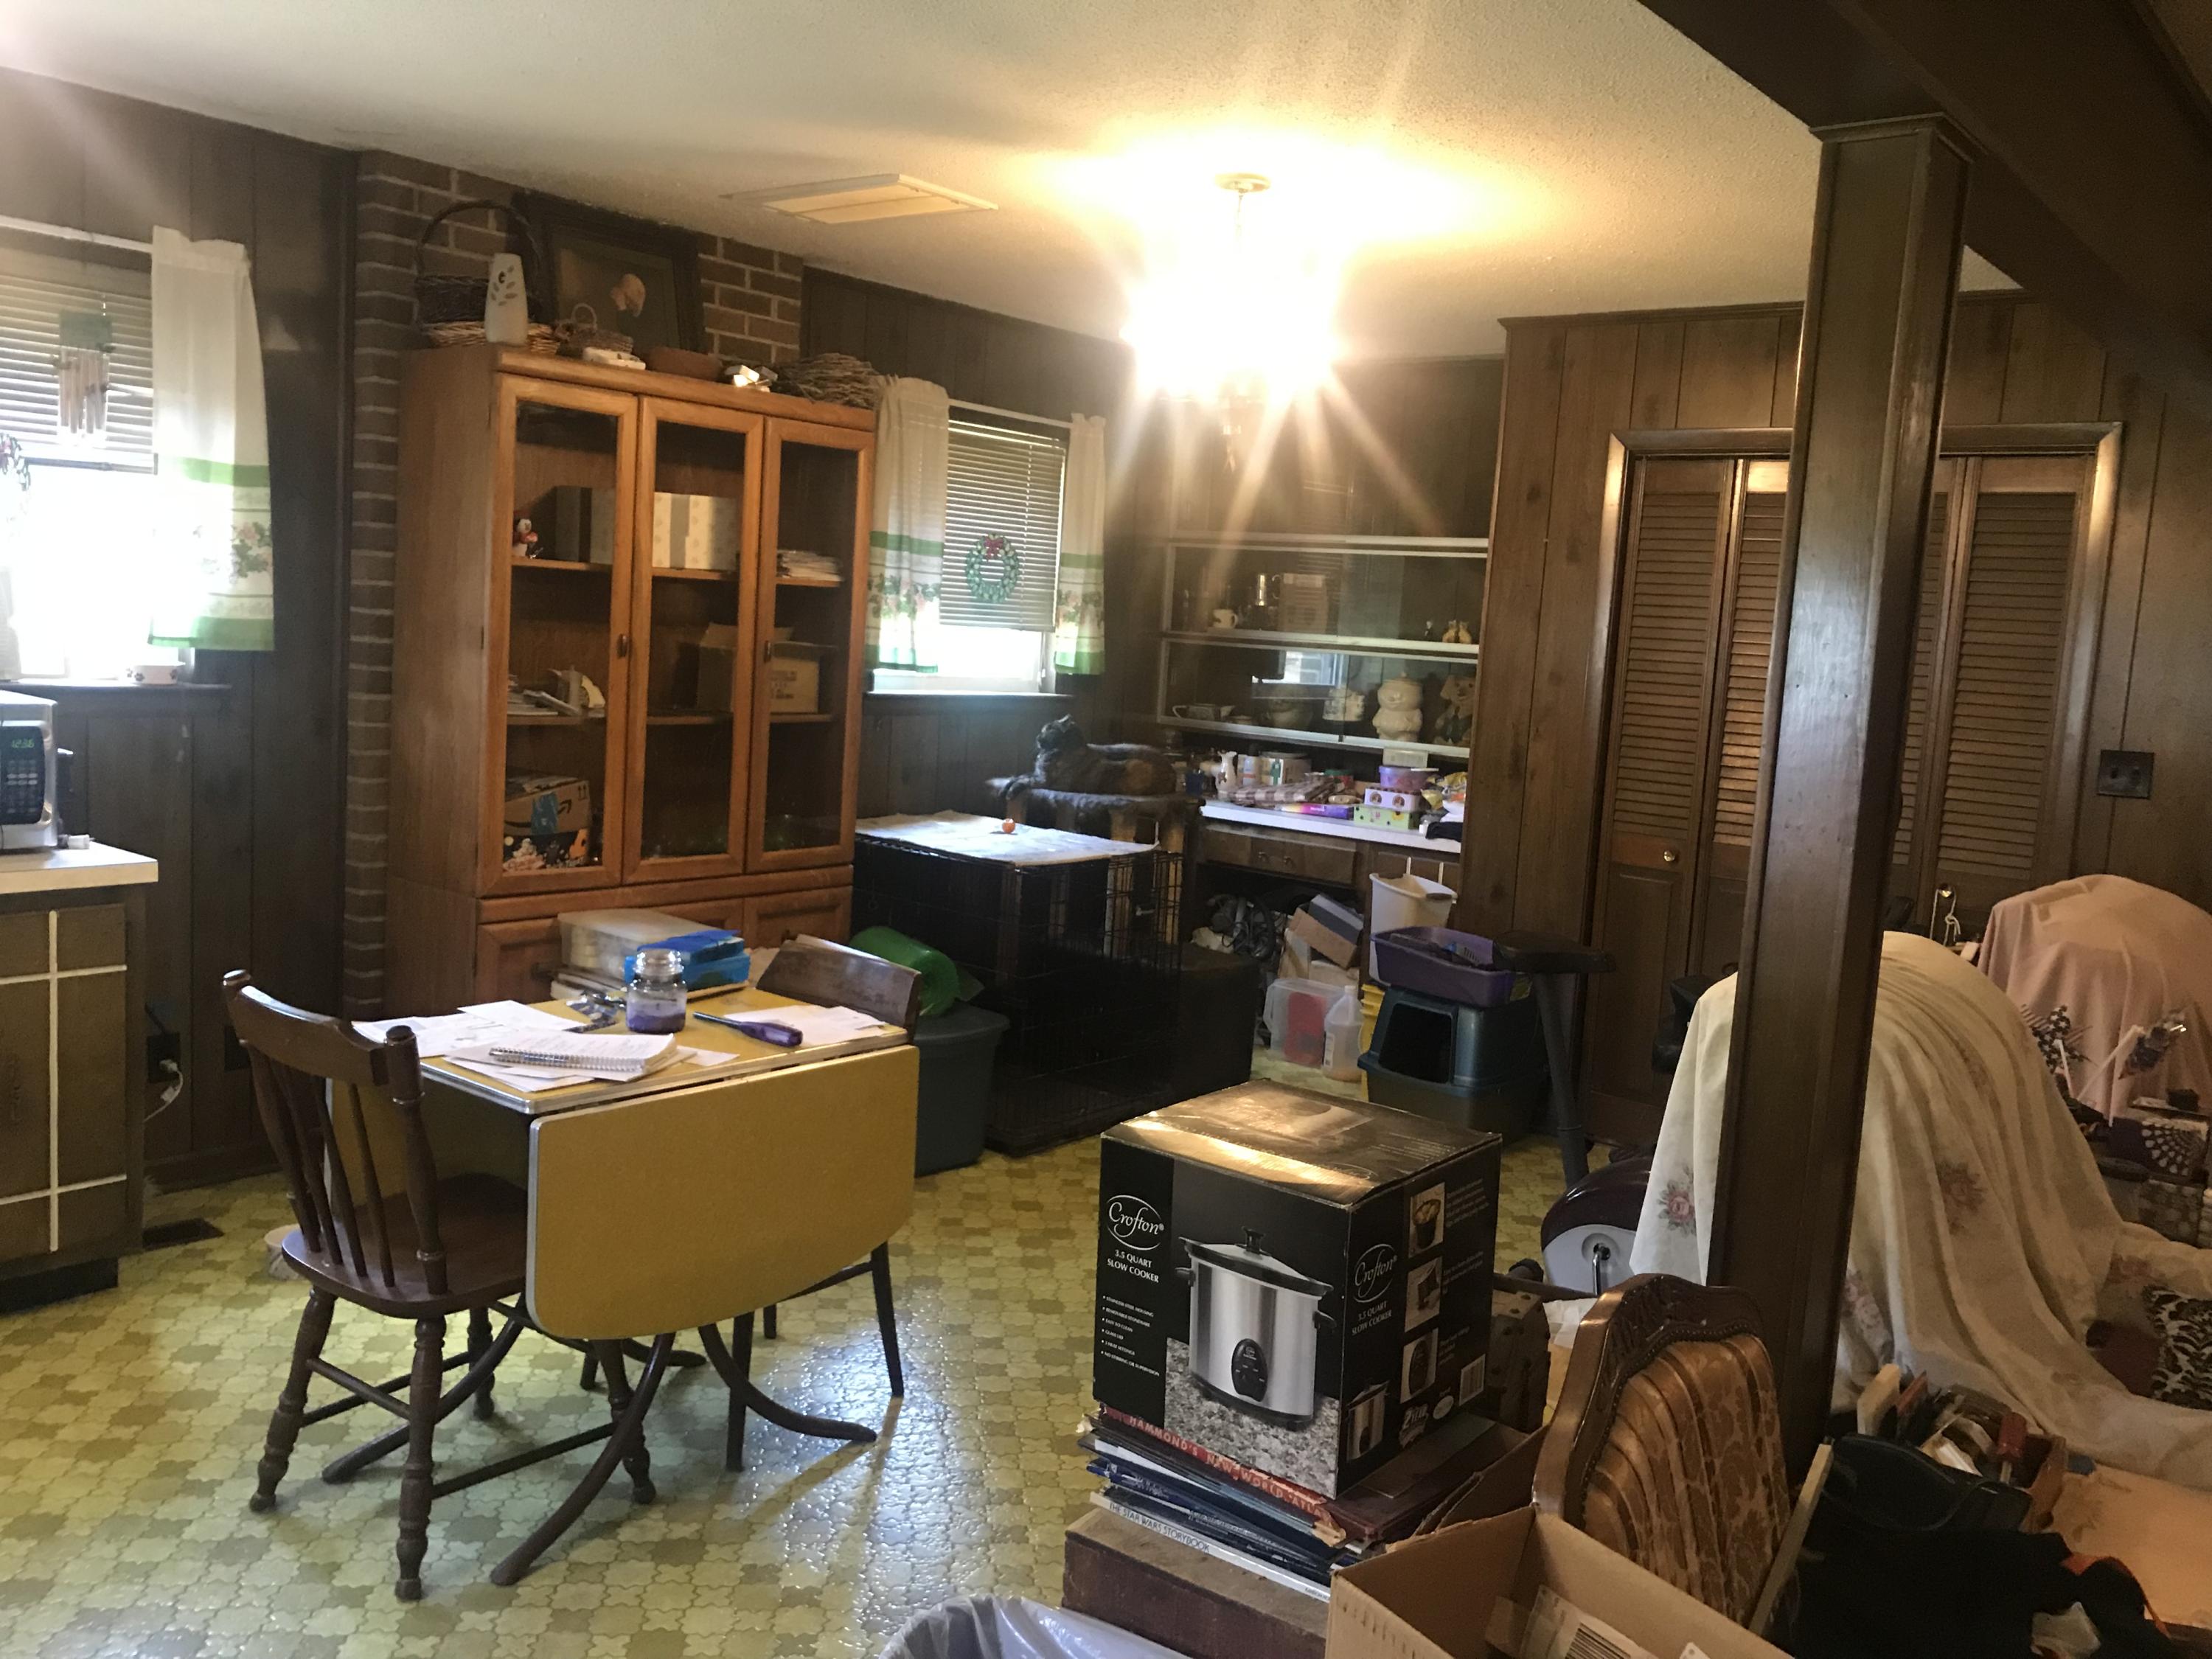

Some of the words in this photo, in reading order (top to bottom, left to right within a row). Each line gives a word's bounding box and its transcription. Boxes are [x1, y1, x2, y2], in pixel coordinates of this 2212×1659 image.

[1109, 1202, 1158, 1237] Crofton
[1107, 1258, 1127, 1271] SLOW
[1129, 1266, 1159, 1283] COOKER
[1115, 1250, 1125, 1259] 3.5
[1127, 1253, 1152, 1267] QUART
[1367, 1301, 1387, 1317] QUART
[1352, 1321, 1368, 1335] SLOW
[1368, 1310, 1392, 1327] COOKER
[1130, 1416, 1198, 1456] HAMMOND'S
[1242, 1469, 1284, 1498] WORLD
[1109, 1503, 1121, 1514] THE
[1122, 1508, 1141, 1522] STAR
[1141, 1517, 1162, 1533] WARS
[1164, 1526, 1211, 1555] STORYBOOK
